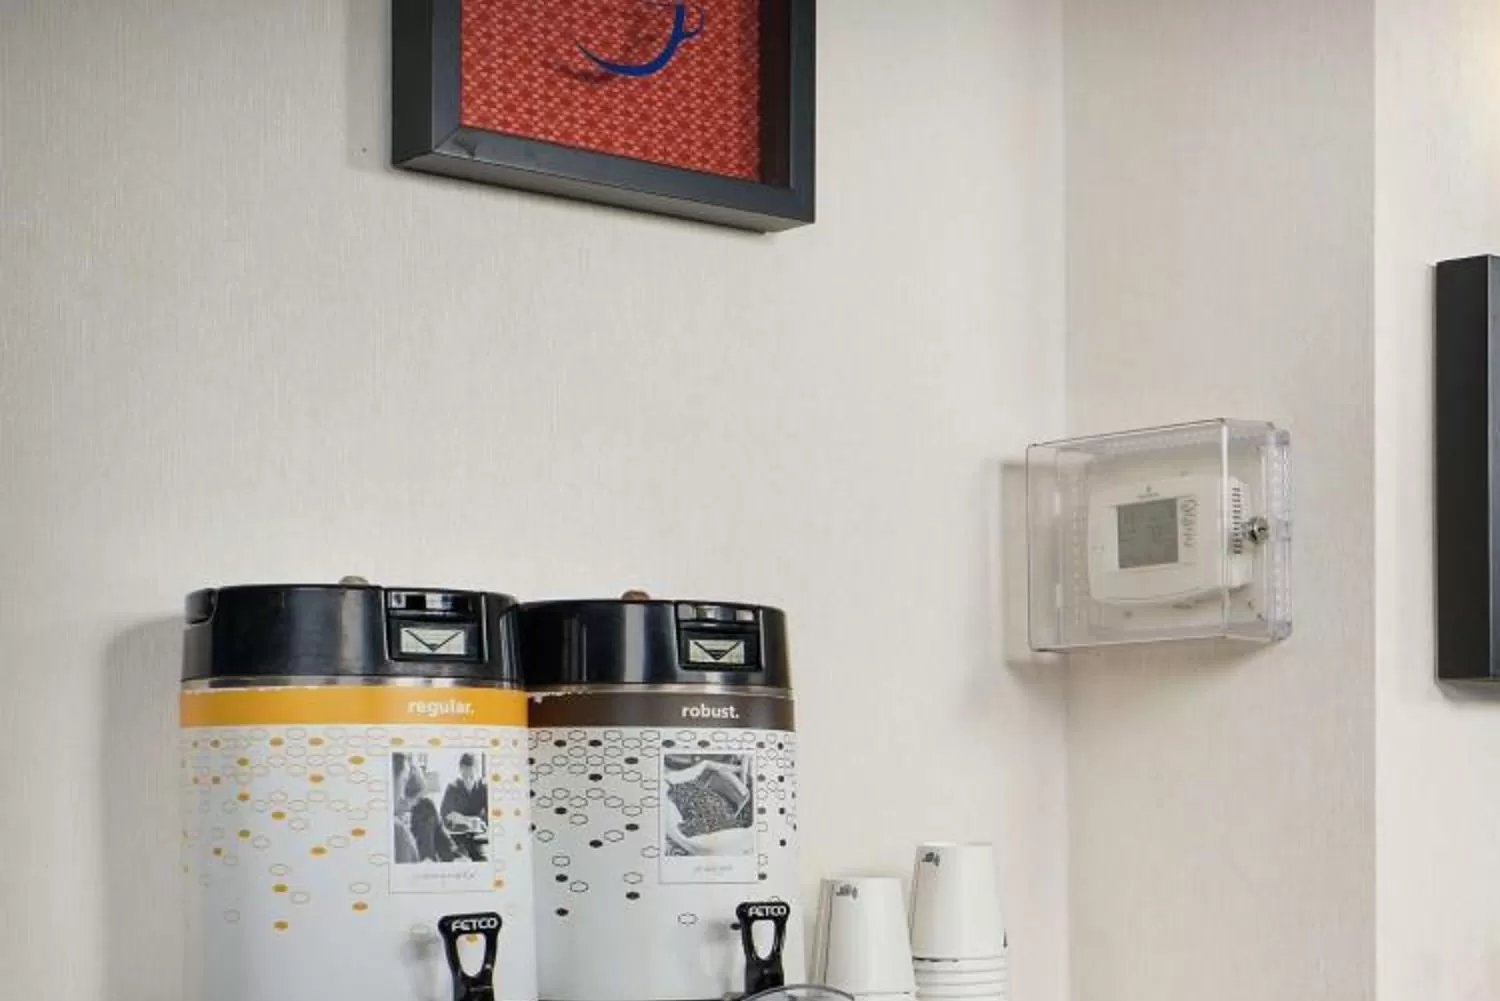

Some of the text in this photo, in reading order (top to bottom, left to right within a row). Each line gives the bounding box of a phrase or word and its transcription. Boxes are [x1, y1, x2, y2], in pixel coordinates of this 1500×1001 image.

[407, 698, 475, 718] regular.
[681, 703, 740, 719] robust.
[748, 905, 787, 917] FETCO
[451, 918, 498, 932] FETCO
